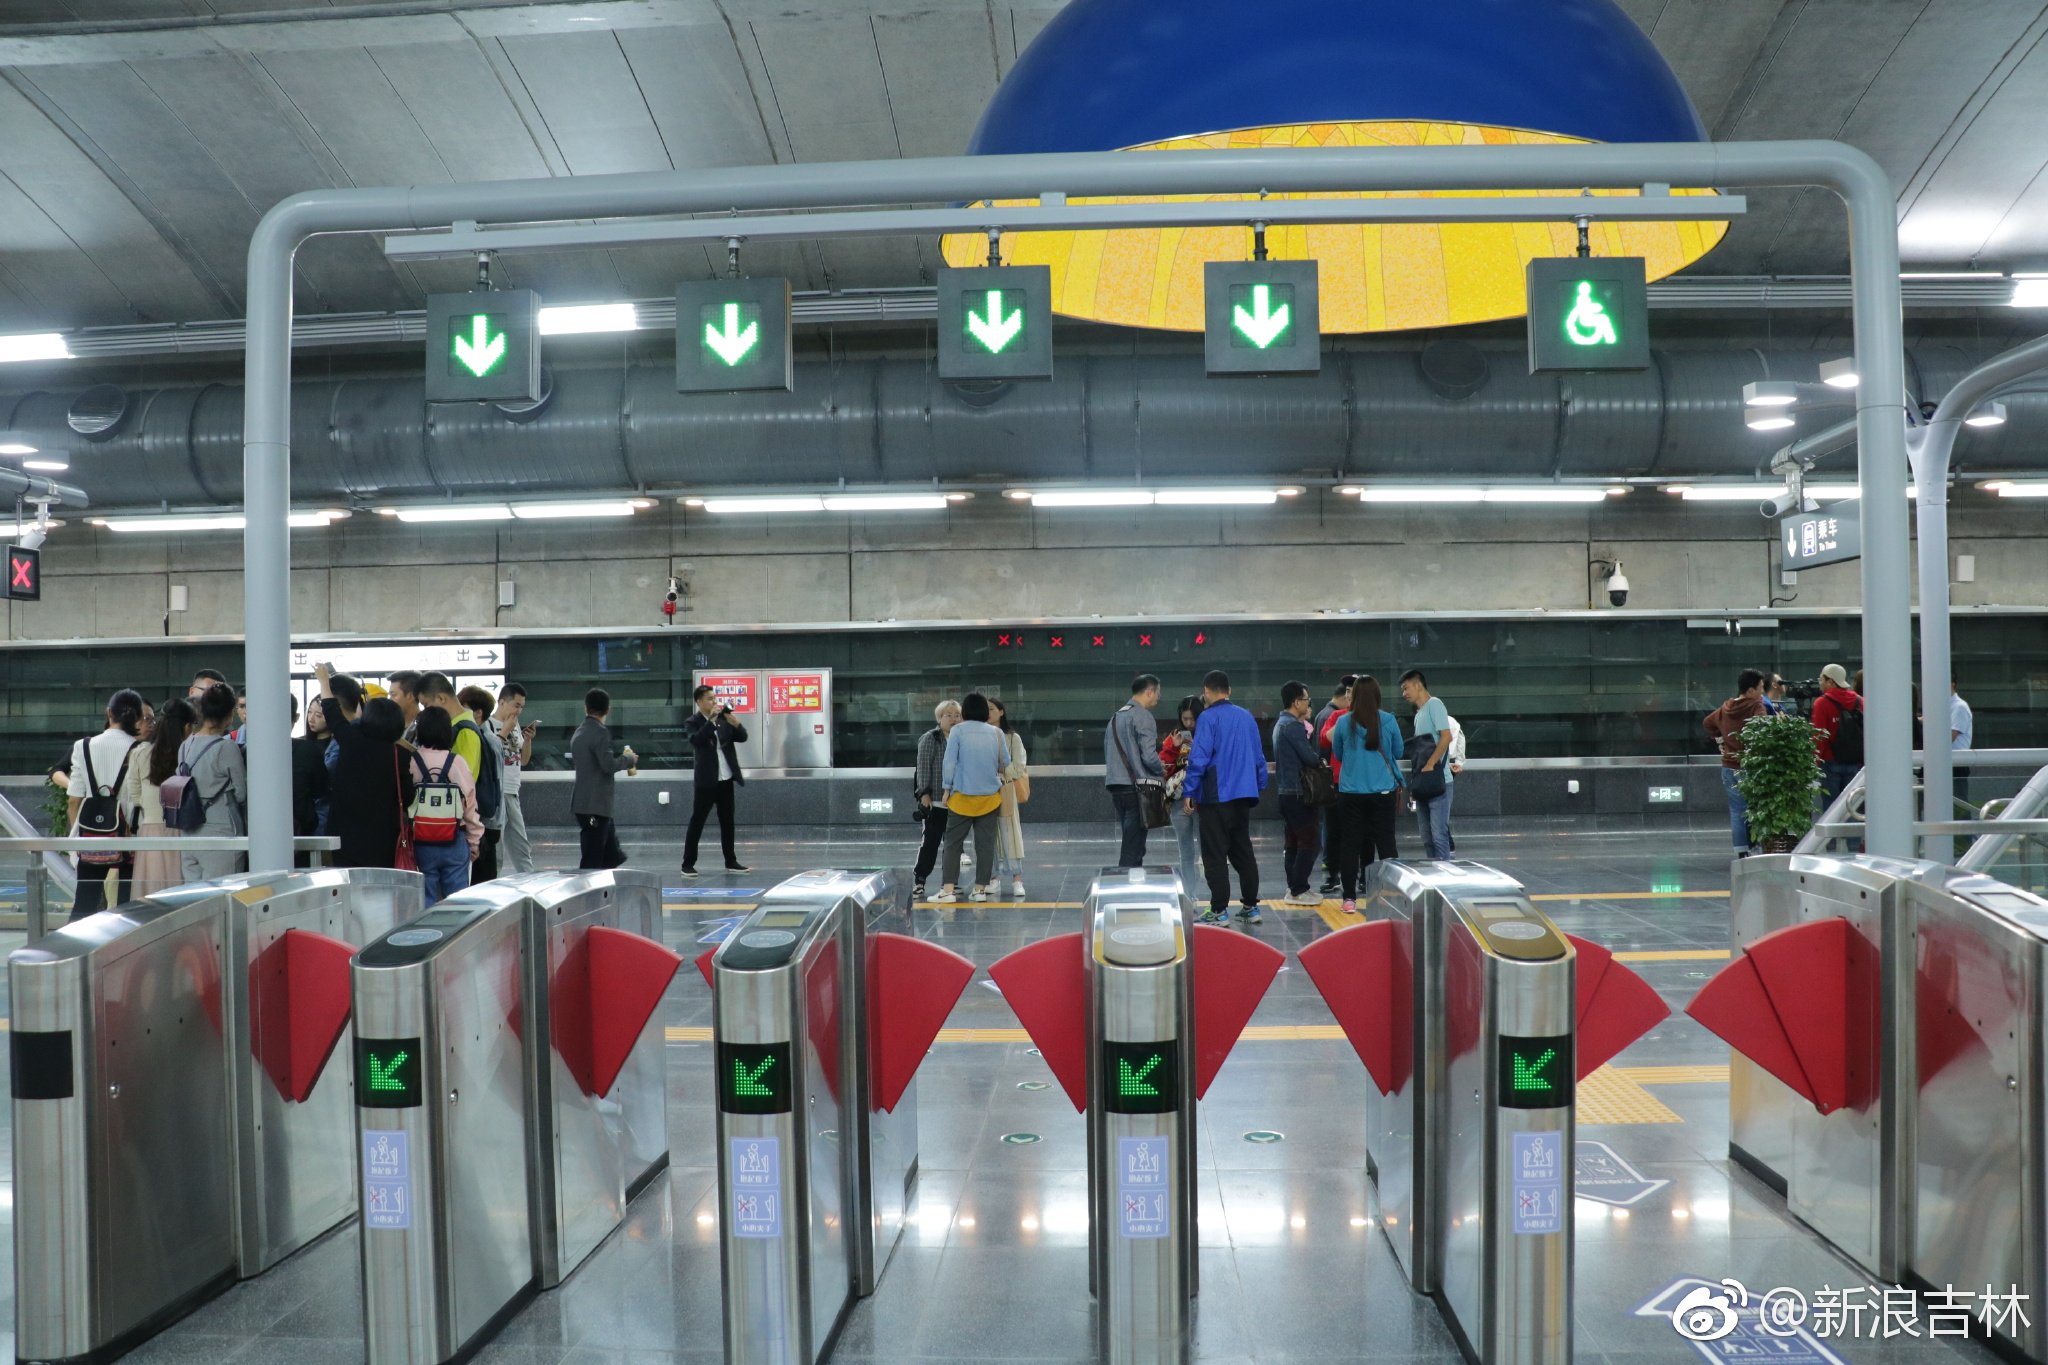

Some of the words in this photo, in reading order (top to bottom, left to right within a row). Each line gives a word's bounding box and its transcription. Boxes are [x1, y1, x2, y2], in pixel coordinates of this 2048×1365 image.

[1818, 518, 1838, 540] 乘车
[294, 652, 307, 665] 出
[457, 648, 470, 662] 出
